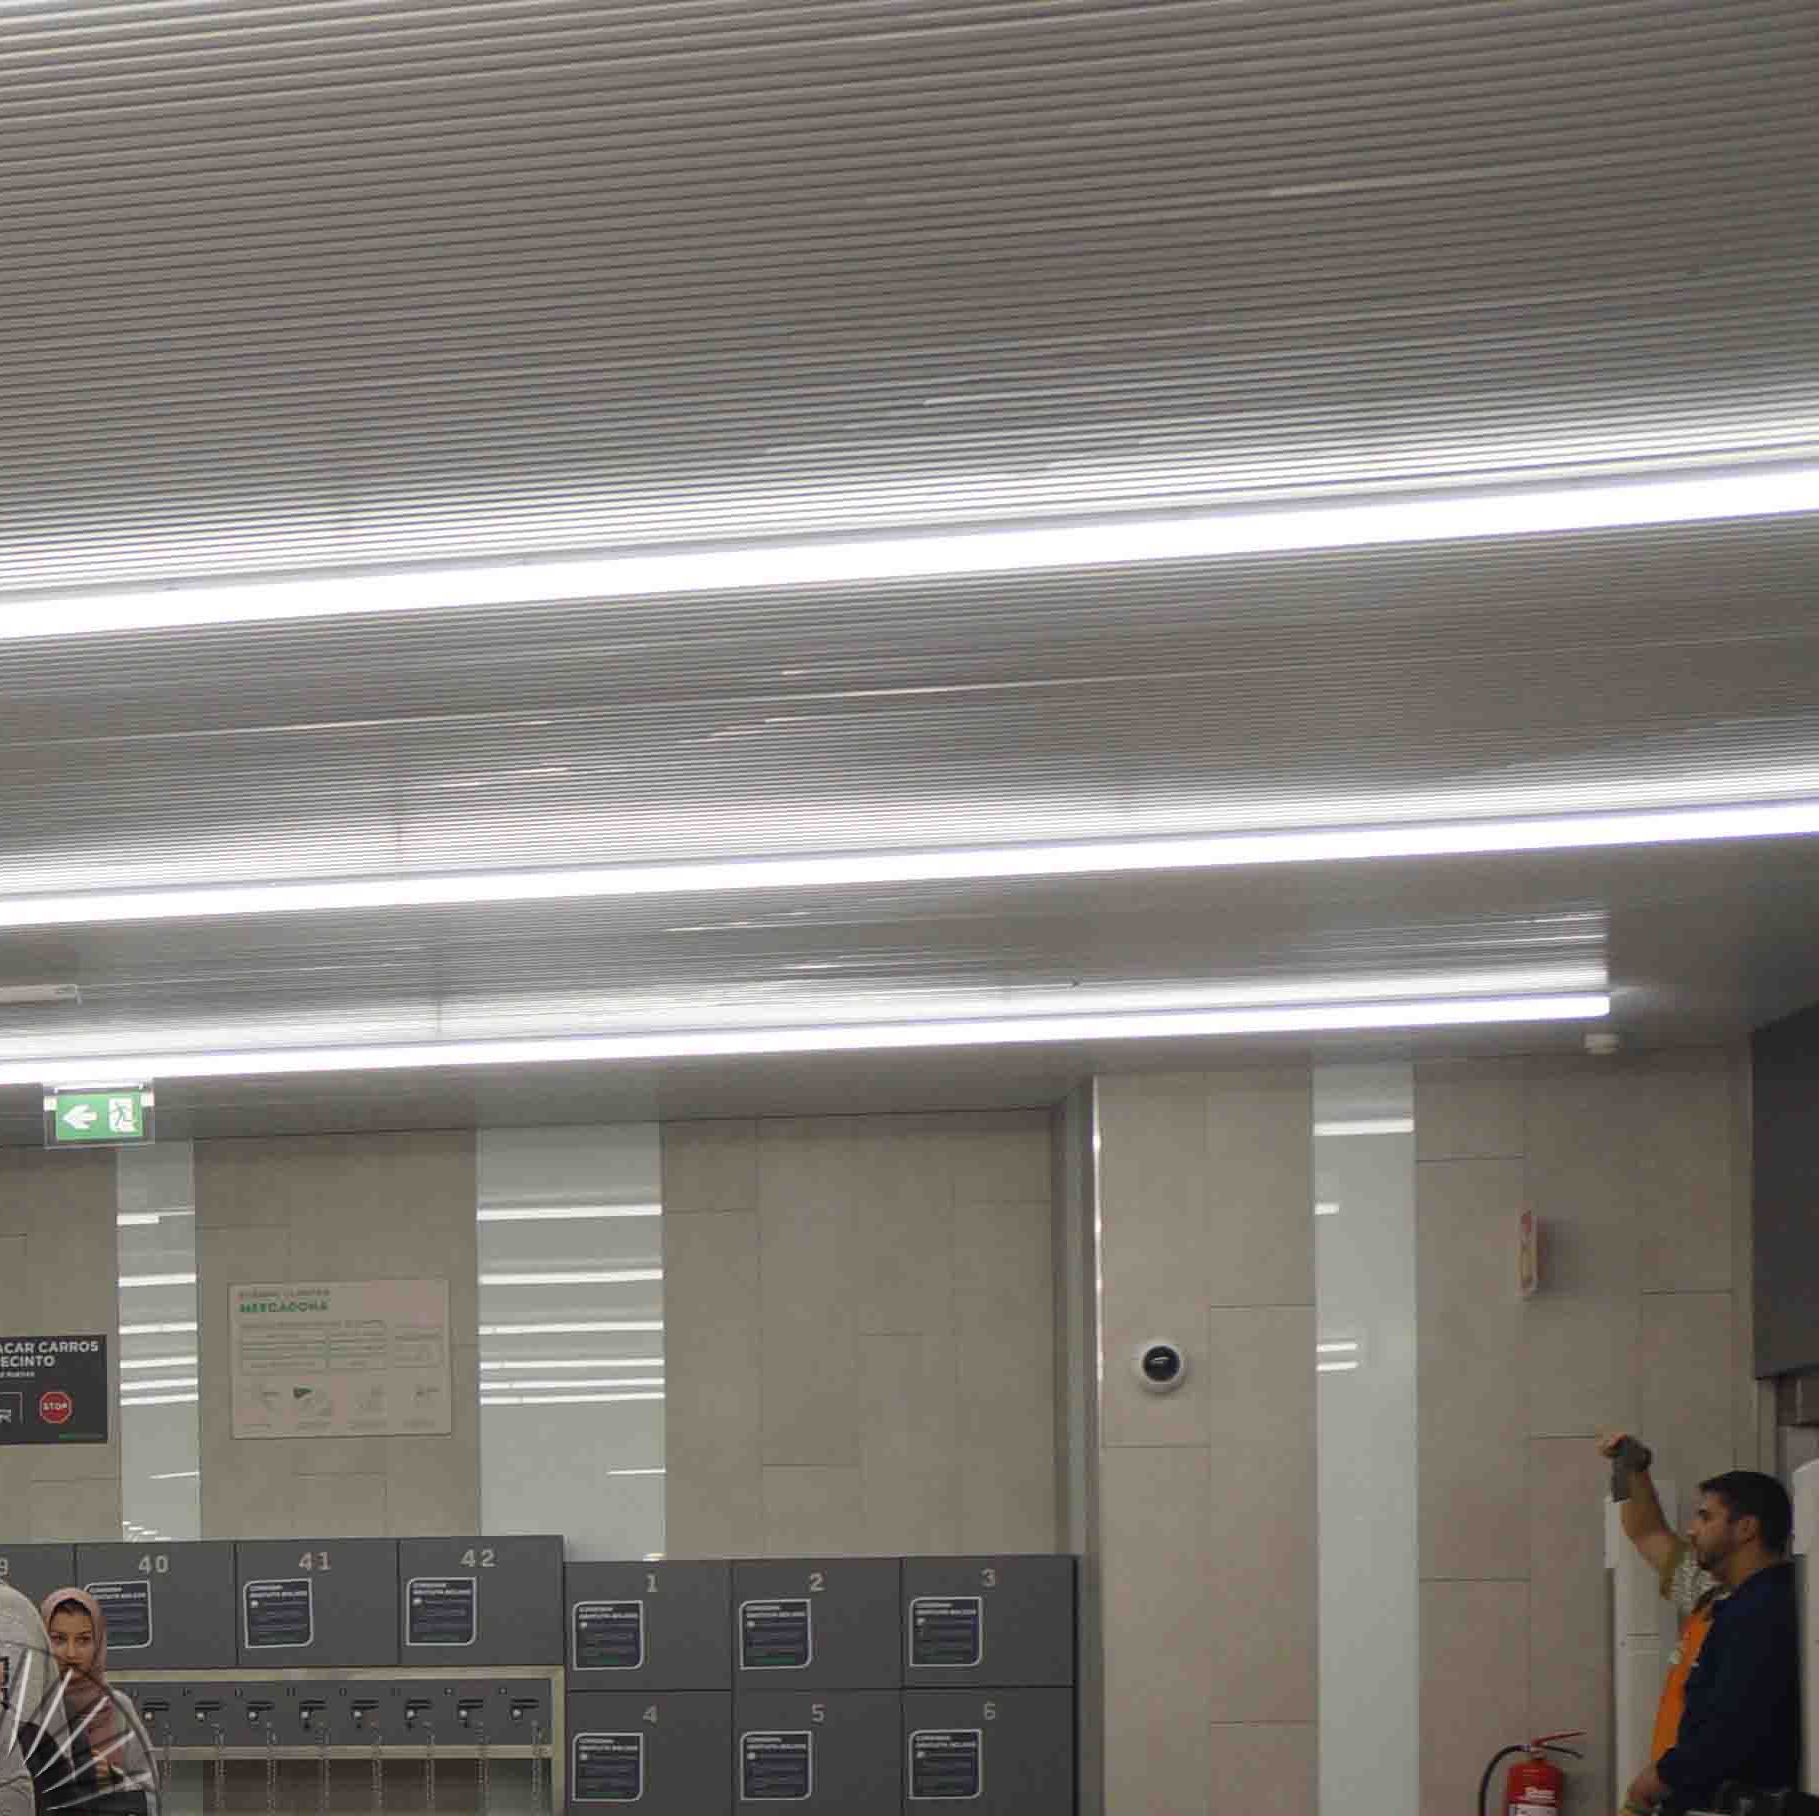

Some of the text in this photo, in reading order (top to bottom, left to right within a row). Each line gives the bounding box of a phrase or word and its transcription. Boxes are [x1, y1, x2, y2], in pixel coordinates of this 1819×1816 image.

[38, 1340, 100, 1354] CARROS
[138, 1555, 170, 1574] 40
[299, 1551, 331, 1571] 41
[460, 1548, 496, 1568] 42
[647, 1573, 659, 1593] 1
[810, 1572, 825, 1592] 2
[980, 1568, 996, 1588] 3
[643, 1705, 659, 1724] 4
[812, 1703, 825, 1723] 5
[983, 1700, 997, 1721] 6
